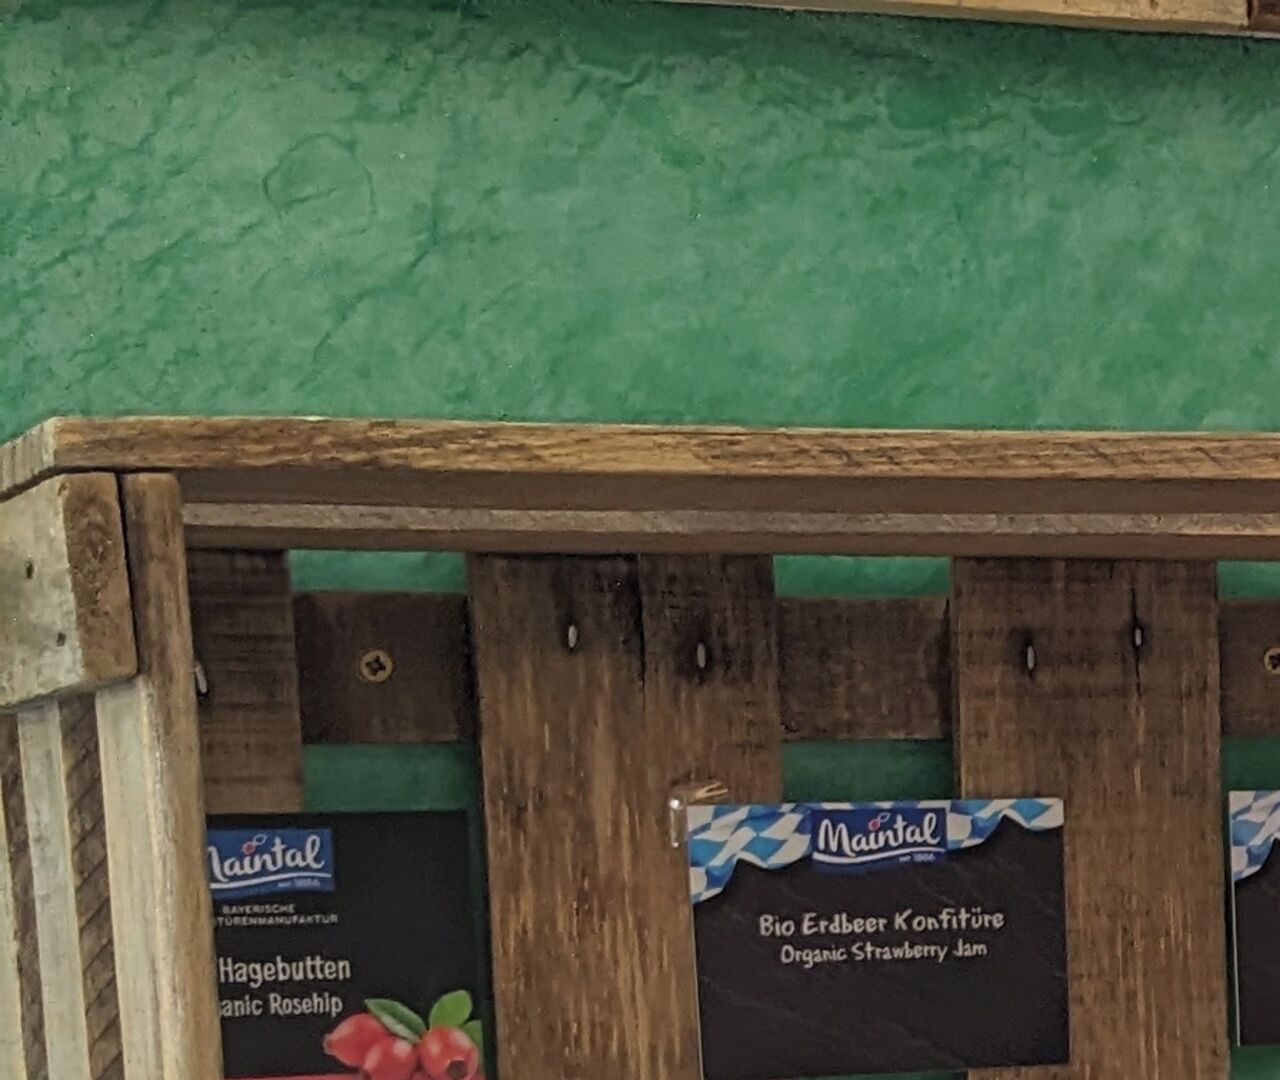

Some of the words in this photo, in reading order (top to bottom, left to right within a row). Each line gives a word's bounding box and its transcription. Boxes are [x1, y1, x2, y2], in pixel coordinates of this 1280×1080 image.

[818, 812, 941, 858] Maintal
[216, 914, 339, 926] TÜRENMANUFAKTUR
[222, 903, 296, 914] BAYERISCHE
[759, 914, 795, 937] Bio
[802, 912, 887, 935] Erdbeer
[893, 907, 1005, 931] Konfitüre
[780, 943, 848, 969] Organic
[851, 940, 949, 963] Strawberry
[953, 937, 988, 957] Jam
[219, 954, 352, 989] Hagebutten
[219, 994, 263, 1017] anic
[269, 991, 344, 1018] Rosehip
